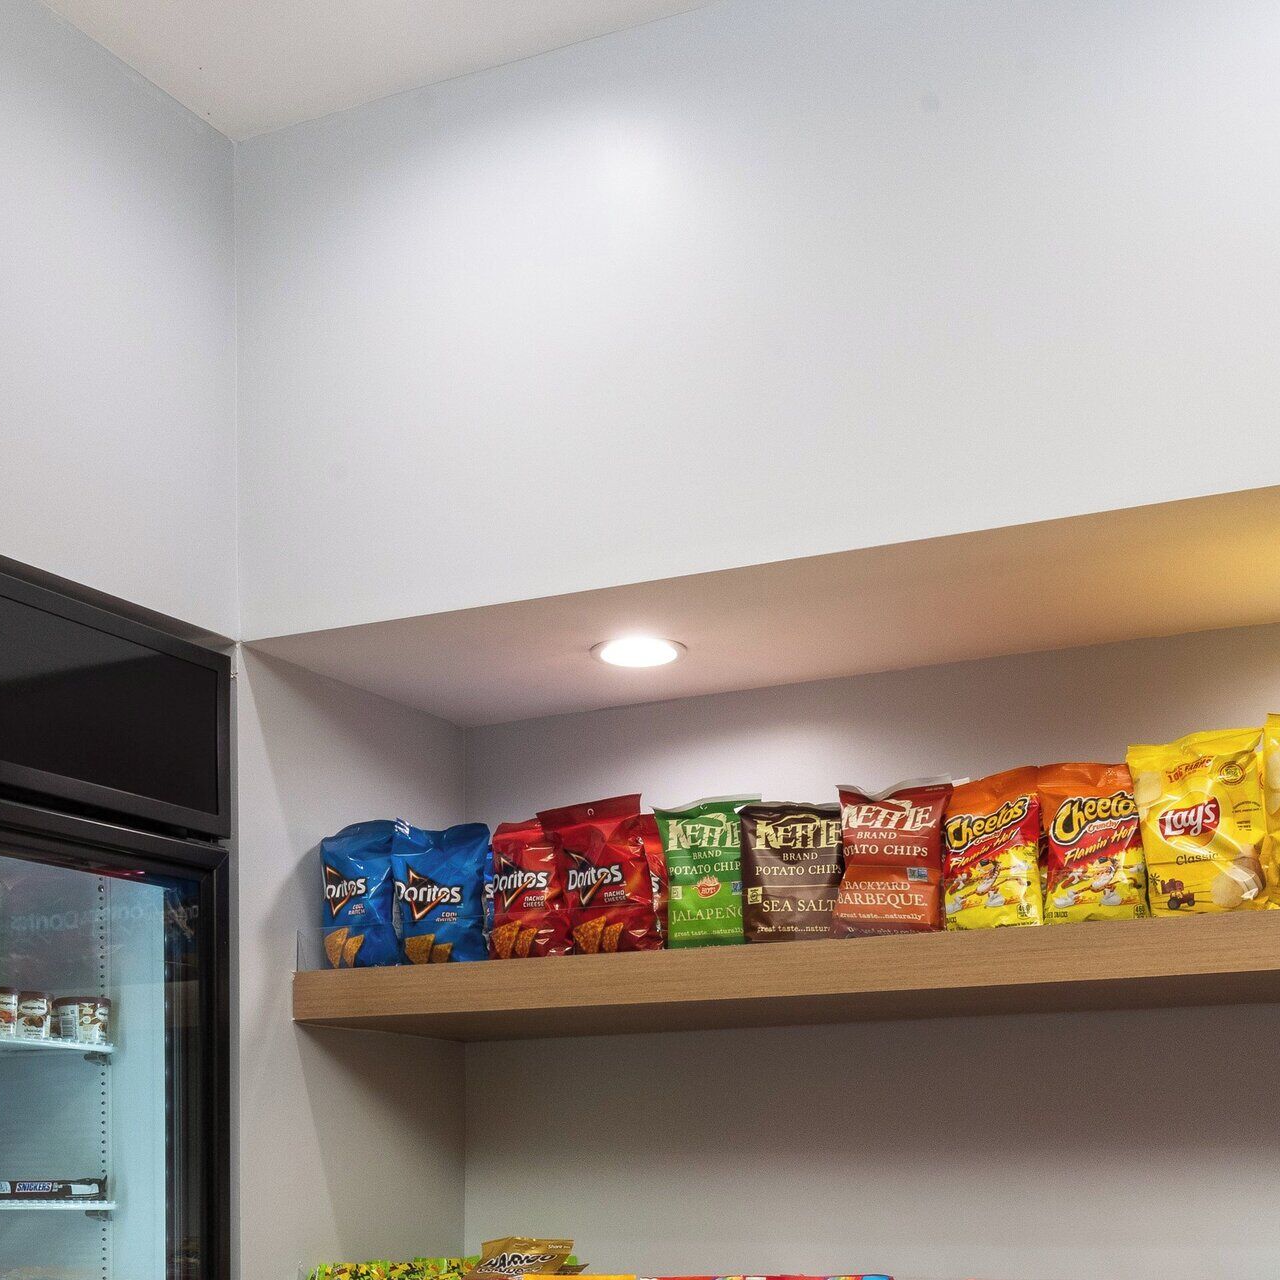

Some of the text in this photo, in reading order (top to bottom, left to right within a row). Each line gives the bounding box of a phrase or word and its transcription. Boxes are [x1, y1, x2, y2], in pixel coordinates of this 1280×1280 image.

[841, 799, 935, 831] KETTLE
[1163, 801, 1218, 836] Lay's
[752, 813, 842, 850] KETTLE
[945, 796, 1030, 853] Cheetos
[1086, 820, 1118, 833] Crunchy
[666, 812, 742, 852] KETTLE
[856, 831, 897, 840] BRAND
[692, 850, 722, 860] BRAND
[883, 844, 928, 857] CHIPS
[950, 827, 1021, 869] Flamin' Hot
[1064, 836, 1110, 866] Flamin'
[782, 851, 818, 861] BRAND
[1176, 851, 1219, 866] Classic
[669, 864, 712, 875] POTATO
[755, 864, 805, 876] POTATO
[493, 871, 548, 893] Doritos
[568, 863, 624, 891] Doritos
[395, 881, 462, 904] Doritos
[845, 881, 910, 892] BACKYARD
[762, 899, 837, 912] SEA SALT
[674, 930, 693, 938] great
[16, 1182, 52, 1192] SNICKERS
